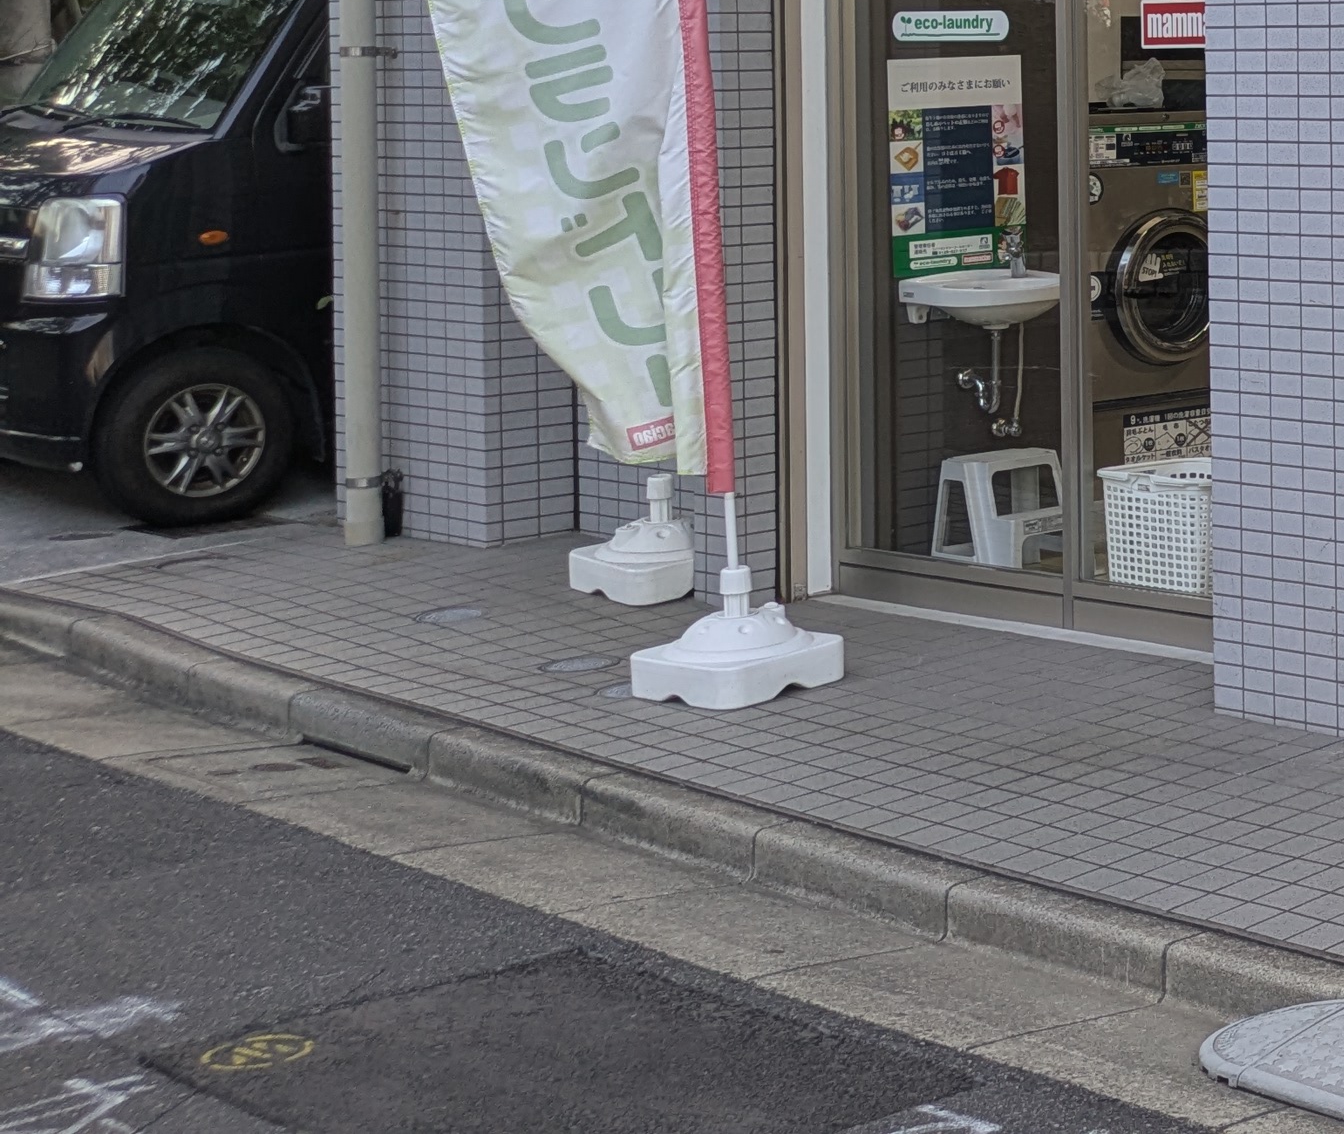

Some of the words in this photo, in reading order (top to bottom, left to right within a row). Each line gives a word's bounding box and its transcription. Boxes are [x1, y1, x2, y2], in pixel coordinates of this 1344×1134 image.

[914, 13, 993, 35] eco-laundry
[1147, 13, 1205, 39] mamm
[901, 78, 1011, 93] ご利用のみなさまにお願い
